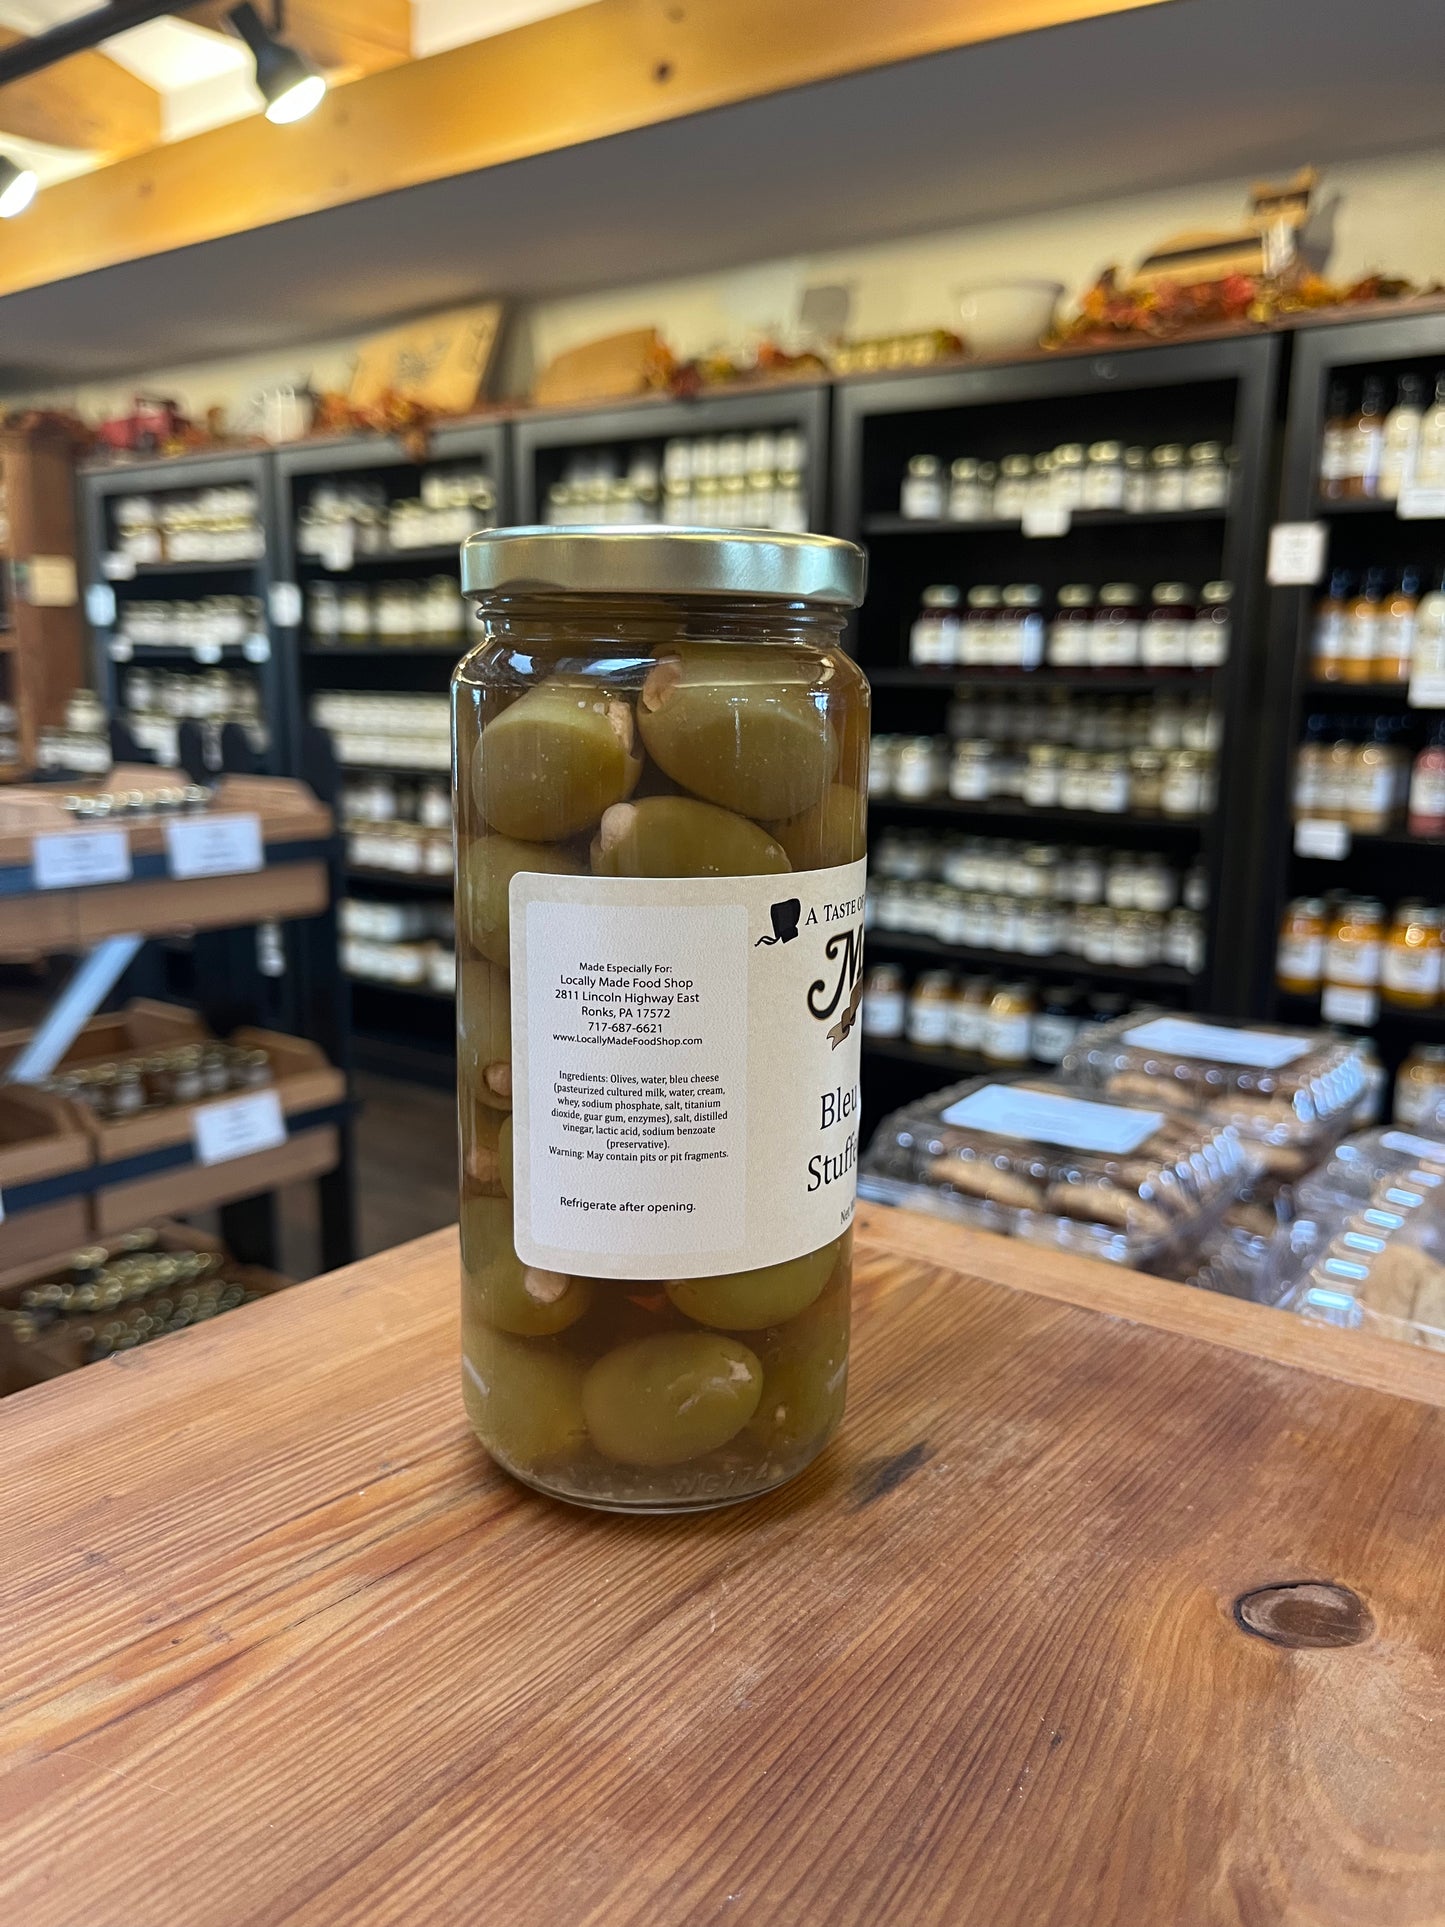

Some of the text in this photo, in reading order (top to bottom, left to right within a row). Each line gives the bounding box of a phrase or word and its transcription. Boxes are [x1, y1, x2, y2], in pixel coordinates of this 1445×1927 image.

[805, 907, 818, 926] A
[824, 899, 856, 922] TASTE
[579, 962, 672, 974] Made Especially For:
[560, 975, 693, 990] Locally Made Food Shop
[555, 989, 699, 1005] 2811 Lincoln Highway East
[582, 1006, 670, 1018] Ronks, PA 17572
[588, 1022, 662, 1033] 717-687-6621
[553, 1034, 703, 1047] www.LocallyMadeFoodShop.com
[559, 1070, 719, 1085] Ingredients: Olives, water, bleu cheese
[553, 1083, 725, 1098] (pasteurized cultured milk, water, cream,
[558, 1097, 721, 1111] whey, sodium phosphate, salt, titanium
[820, 1085, 857, 1130] Bleu
[551, 1108, 728, 1124] dioxide, guar gum, enzymes), salt, distilled
[562, 1123, 716, 1137] vinegar, lactic acid, sodium benzoate
[606, 1139, 670, 1150] (preservative).
[549, 1146, 729, 1163] Warning: May contain pits or pit fragments.
[560, 1197, 696, 1213] Refrigerate after opening.
